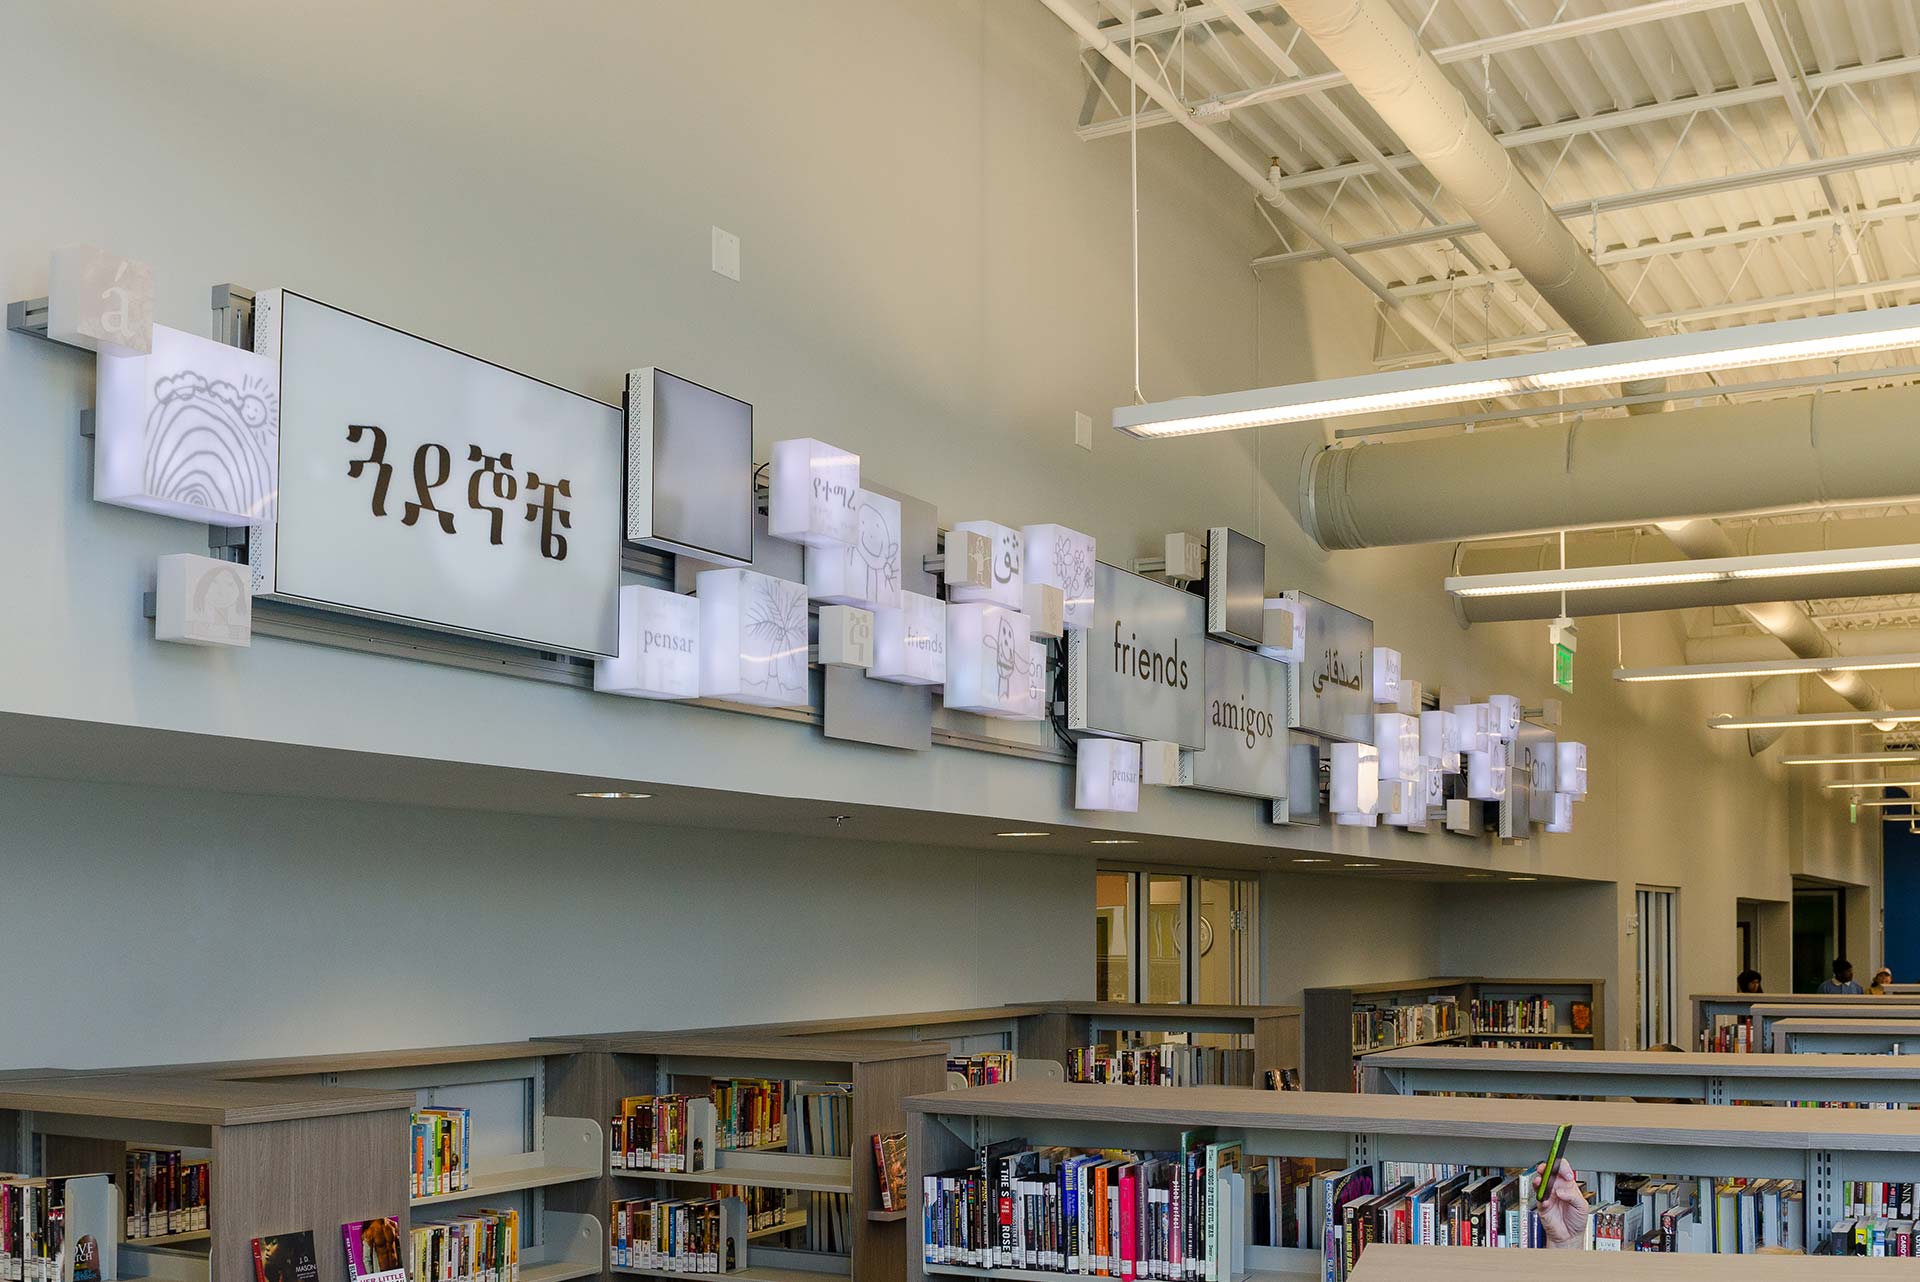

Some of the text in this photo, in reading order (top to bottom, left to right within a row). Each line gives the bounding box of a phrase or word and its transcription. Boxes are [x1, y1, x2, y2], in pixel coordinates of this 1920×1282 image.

[643, 630, 694, 653] pensar
[907, 625, 943, 654] friends
[1114, 620, 1188, 690] friends
[1313, 648, 1363, 699] أصدقائي
[1212, 694, 1273, 749] amigos
[1001, 1169, 1009, 1188] THE
[295, 1264, 317, 1273] MASON
[378, 1273, 404, 1282] LITTLE
